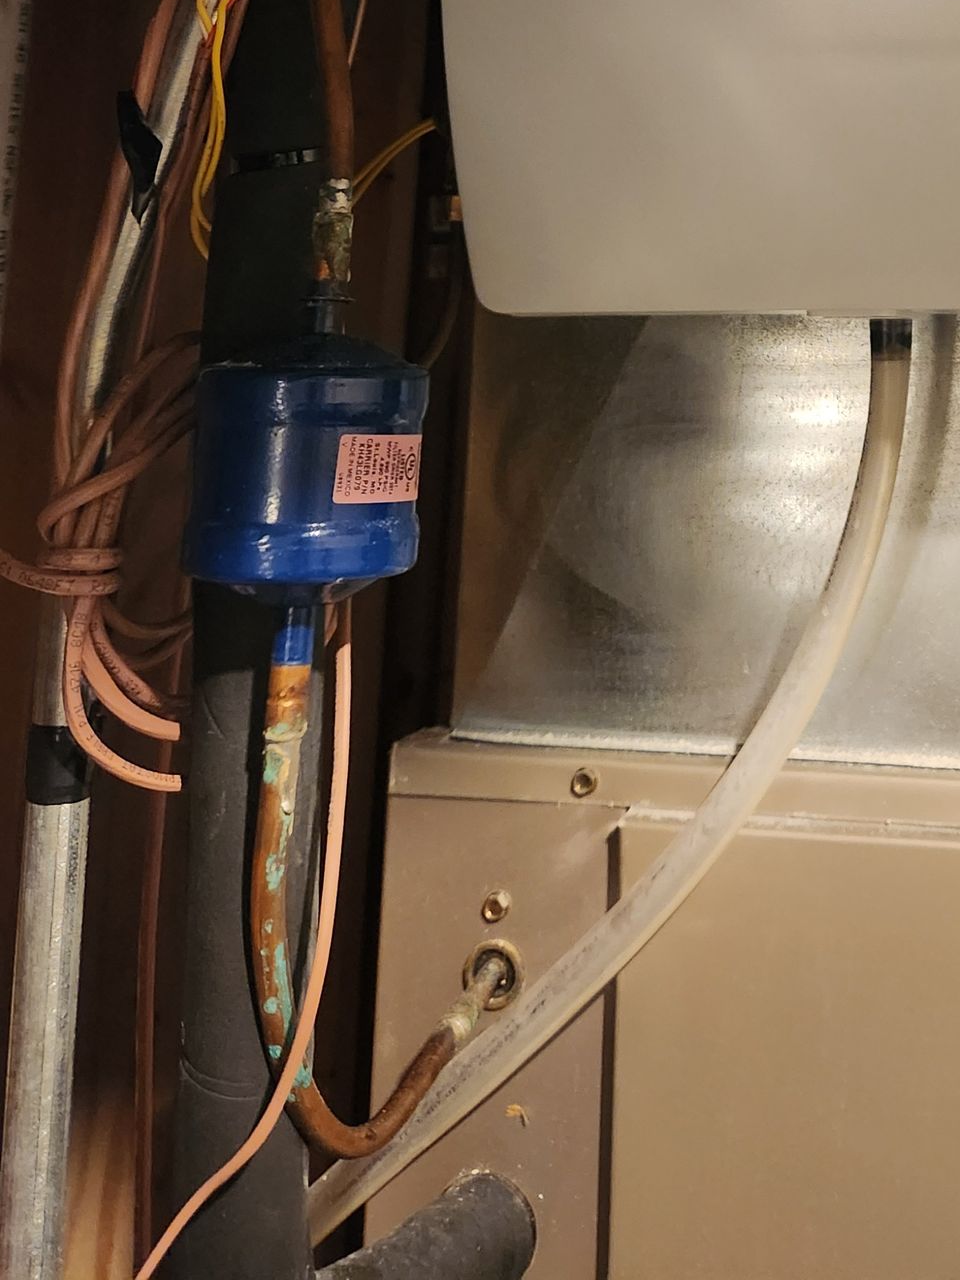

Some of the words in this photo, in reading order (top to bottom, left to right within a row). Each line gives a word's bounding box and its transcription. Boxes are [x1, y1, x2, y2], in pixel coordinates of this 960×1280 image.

[349, 436, 357, 457] MADE
[363, 438, 373, 476] CARRIER
[345, 468, 353, 497] MEXICO
[369, 481, 376, 495] MO
